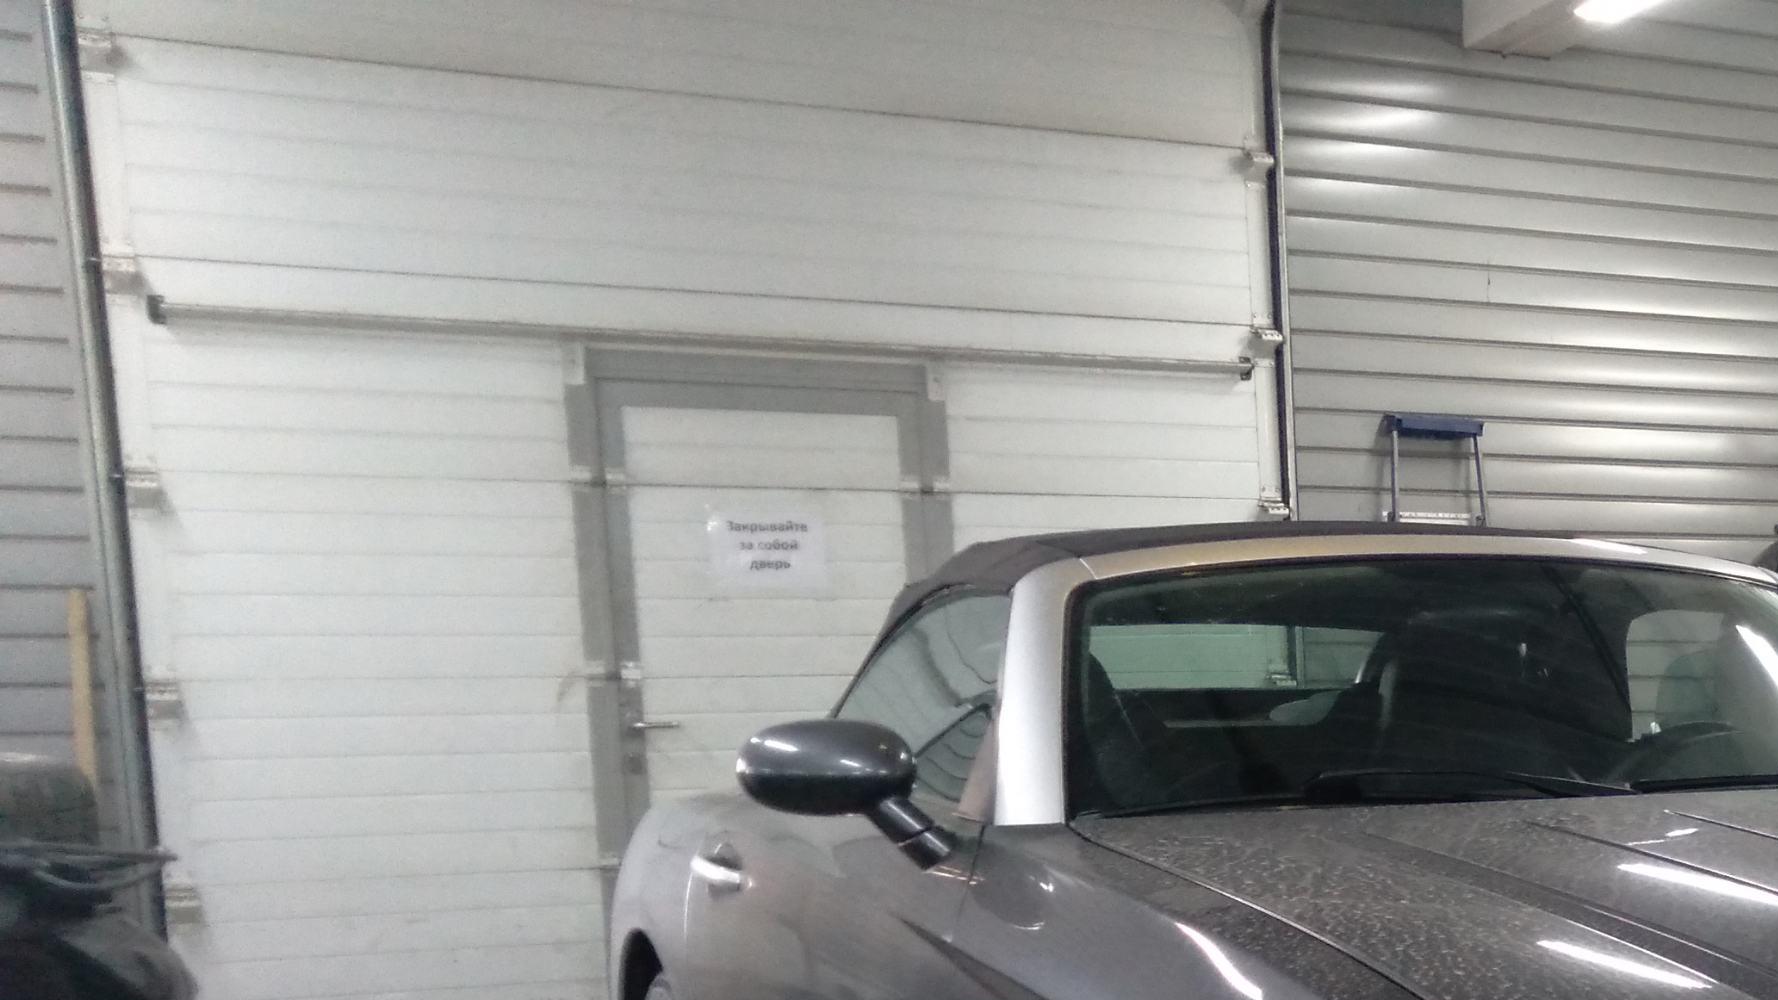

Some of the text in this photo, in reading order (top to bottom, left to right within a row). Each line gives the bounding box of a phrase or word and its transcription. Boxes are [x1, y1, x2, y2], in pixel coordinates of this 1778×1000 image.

[725, 520, 808, 535] Закрывайте
[739, 538, 799, 551] за собой
[750, 560, 791, 571] дверь
